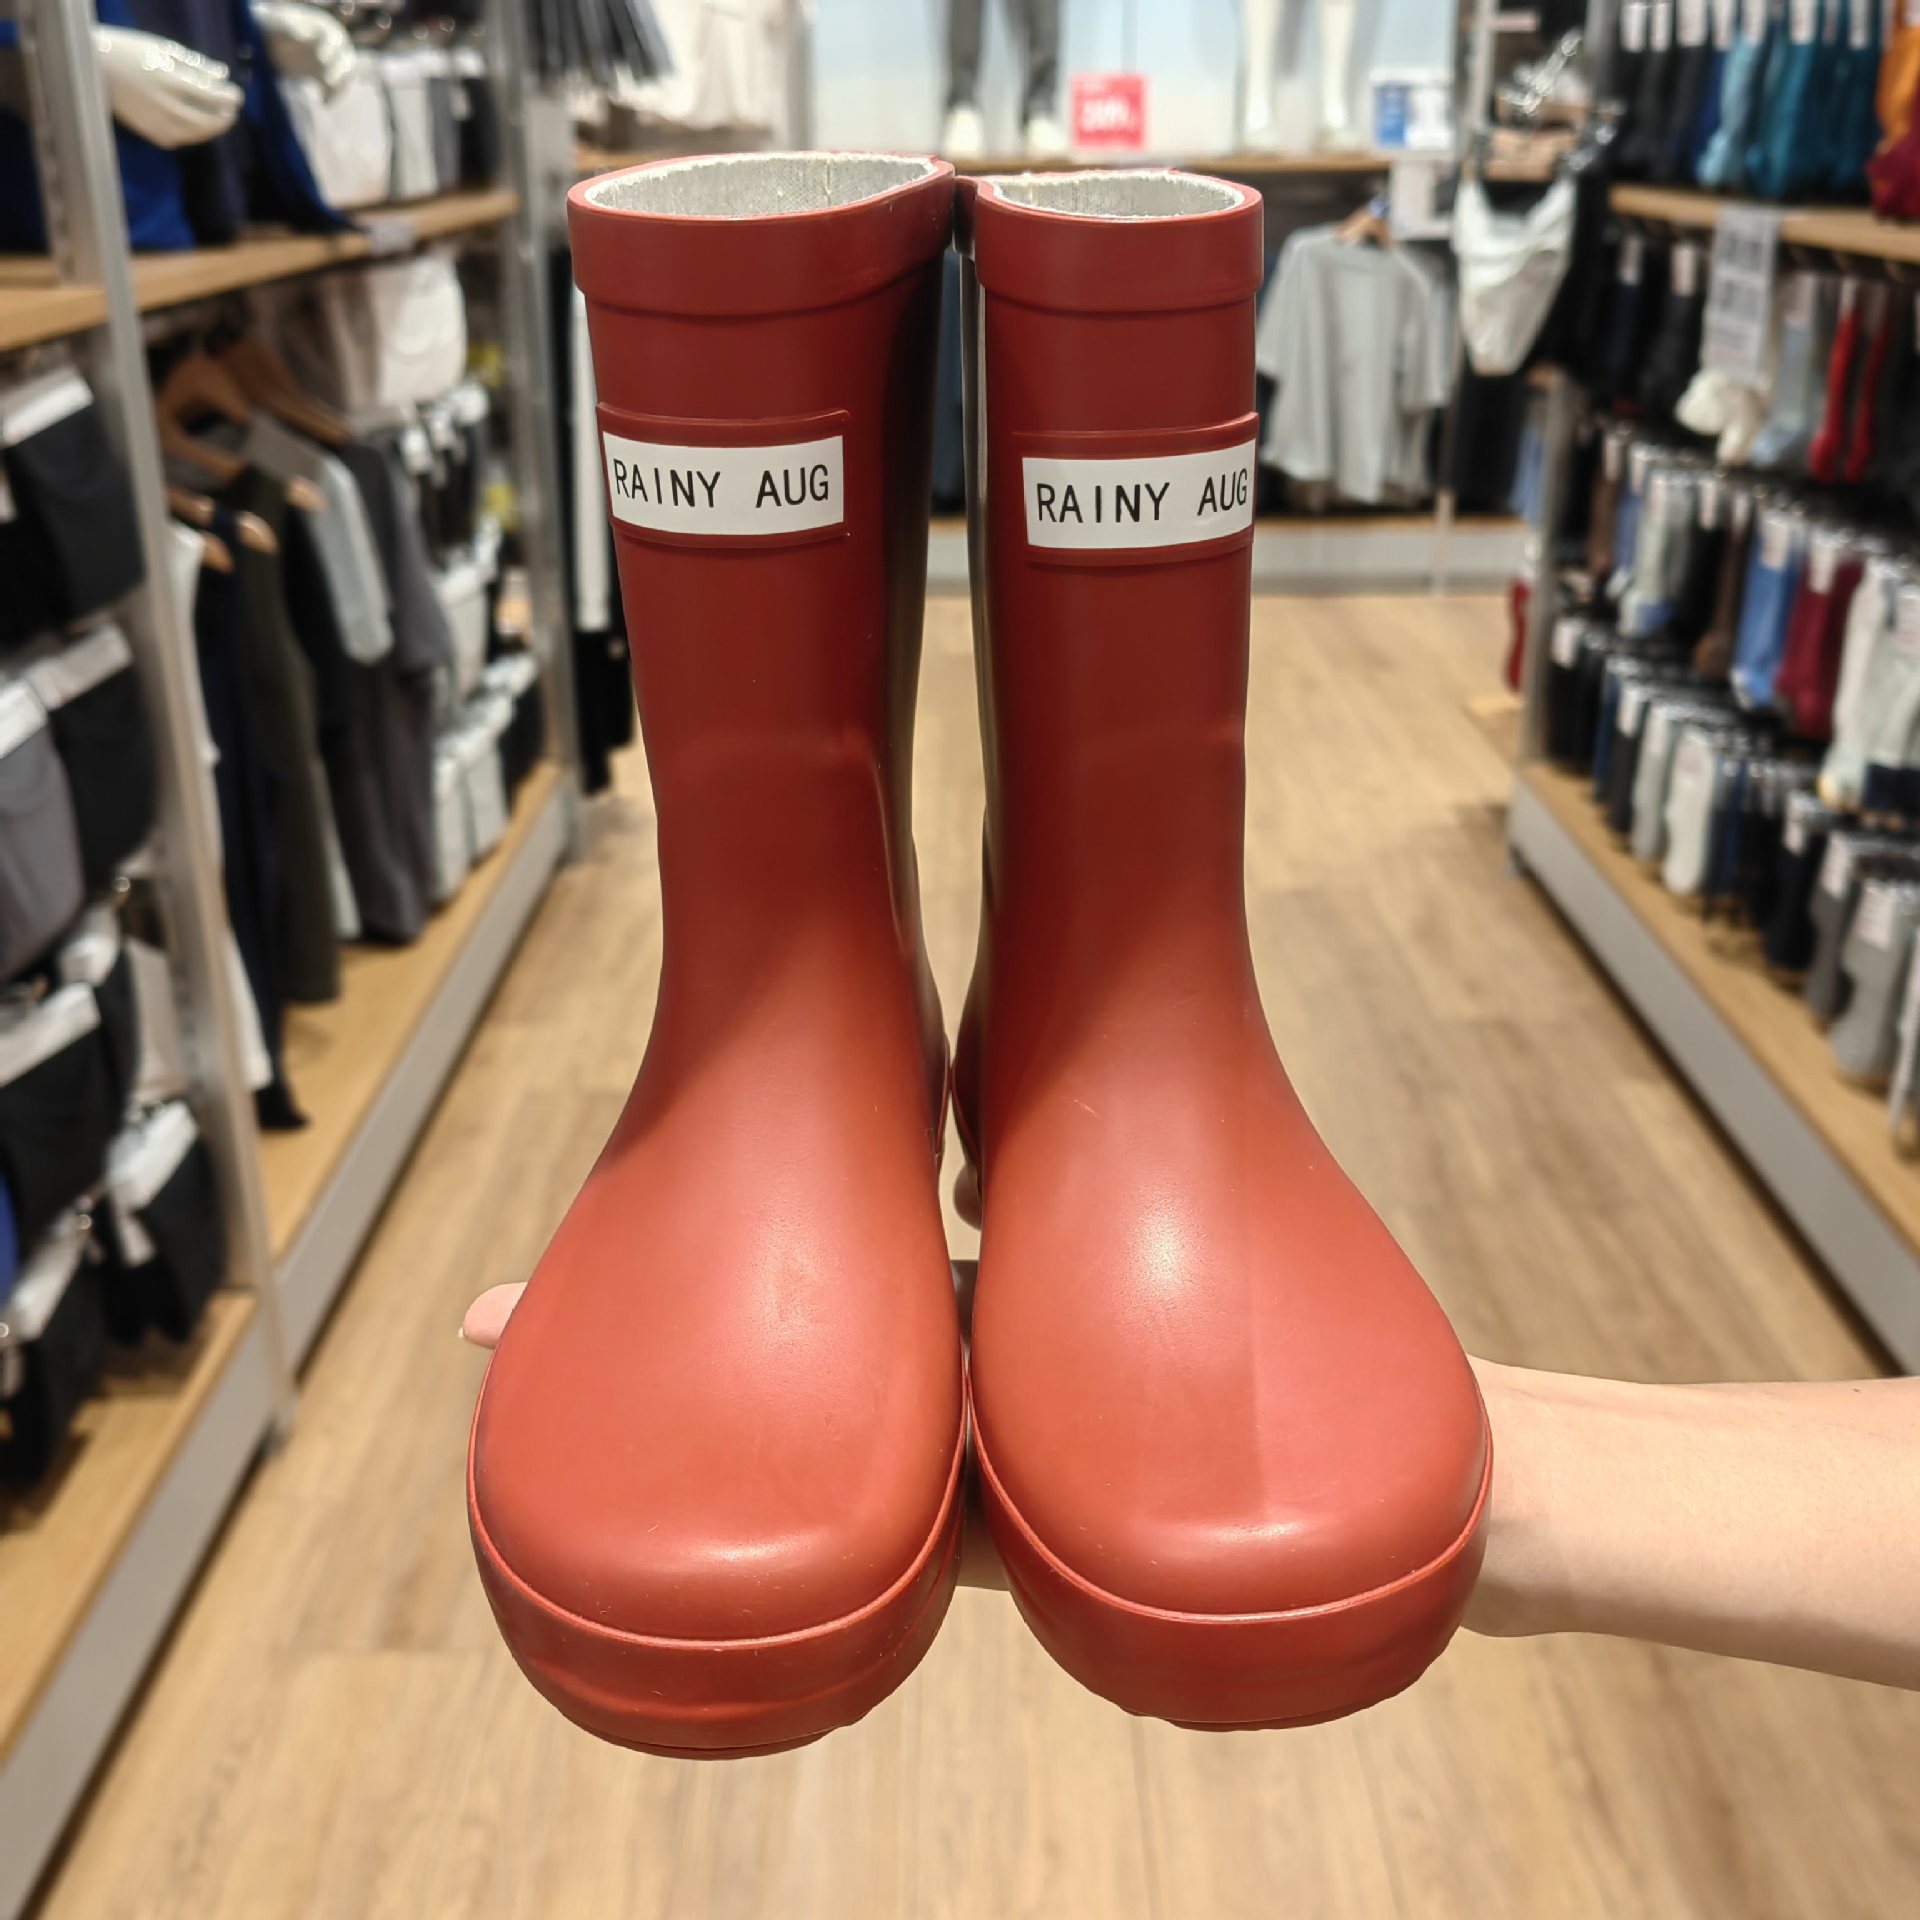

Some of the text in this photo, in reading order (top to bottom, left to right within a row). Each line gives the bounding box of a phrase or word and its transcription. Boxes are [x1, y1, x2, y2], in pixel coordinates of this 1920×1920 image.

[613, 458, 829, 508] RAINY AUG
[1036, 468, 1248, 523] RAINY AUG
